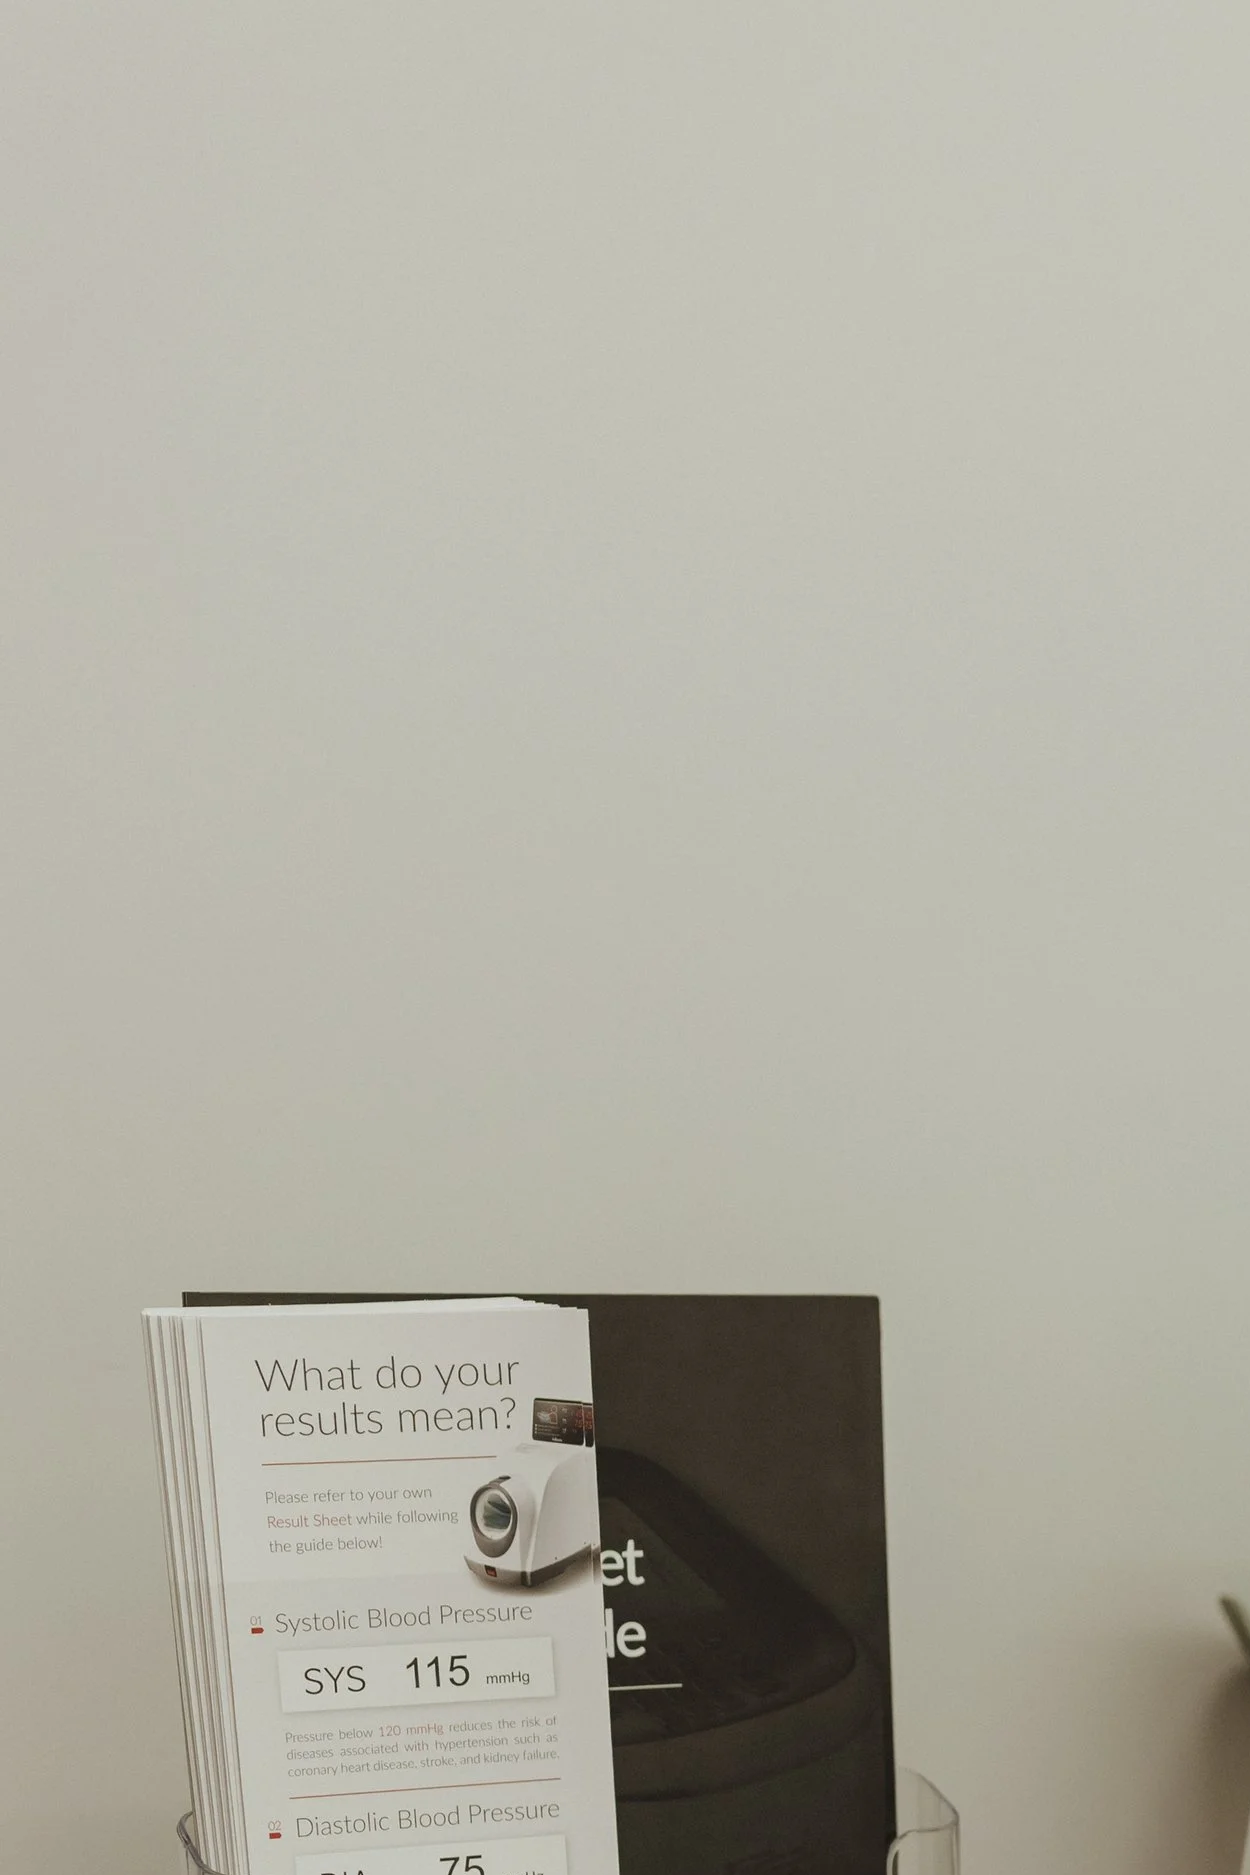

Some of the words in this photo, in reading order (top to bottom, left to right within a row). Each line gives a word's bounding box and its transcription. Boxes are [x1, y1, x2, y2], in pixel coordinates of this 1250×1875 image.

[255, 1357, 362, 1392] What
[376, 1356, 422, 1389] do
[435, 1361, 519, 1395] your
[261, 1401, 383, 1437] results
[399, 1397, 516, 1433] mean?
[265, 1490, 309, 1504] Please
[313, 1488, 345, 1503] refer
[349, 1490, 364, 1502] to
[368, 1489, 399, 1508] your
[402, 1487, 433, 1500] own
[267, 1514, 309, 1529] Result
[313, 1512, 352, 1527] Sheet
[356, 1511, 393, 1525] while
[397, 1509, 459, 1527] following
[269, 1539, 292, 1553] the
[296, 1538, 333, 1556] guide
[337, 1535, 383, 1551] below!
[250, 1615, 262, 1626] 01
[275, 1609, 360, 1637] Systolic
[368, 1606, 432, 1629] Blood
[439, 1603, 533, 1625] Pressure
[304, 1665, 366, 1695] SYS
[406, 1654, 471, 1688] 115
[486, 1671, 530, 1685] mmHg
[285, 1729, 334, 1744] Pressure
[338, 1726, 373, 1740] below
[378, 1725, 401, 1737] 120
[406, 1722, 444, 1738] mmHg
[448, 1719, 493, 1733] reduces
[498, 1717, 517, 1730] the
[521, 1715, 541, 1728] risk
[546, 1714, 559, 1726] of
[286, 1747, 334, 1761] diseases
[340, 1743, 399, 1757] associated
[404, 1740, 429, 1752] with
[434, 1735, 509, 1752] hypertension
[514, 1733, 541, 1746] such
[546, 1733, 559, 1744] as
[287, 1764, 338, 1779] coronary
[340, 1761, 371, 1774] heart
[372, 1757, 418, 1772] disease,
[420, 1755, 458, 1768] stroke,
[460, 1753, 481, 1765] and
[483, 1750, 520, 1765] kidney
[267, 1820, 281, 1831] 02
[296, 1812, 390, 1838] Diastolic
[398, 1806, 461, 1830] Blood
[468, 1801, 560, 1825] Pressure
